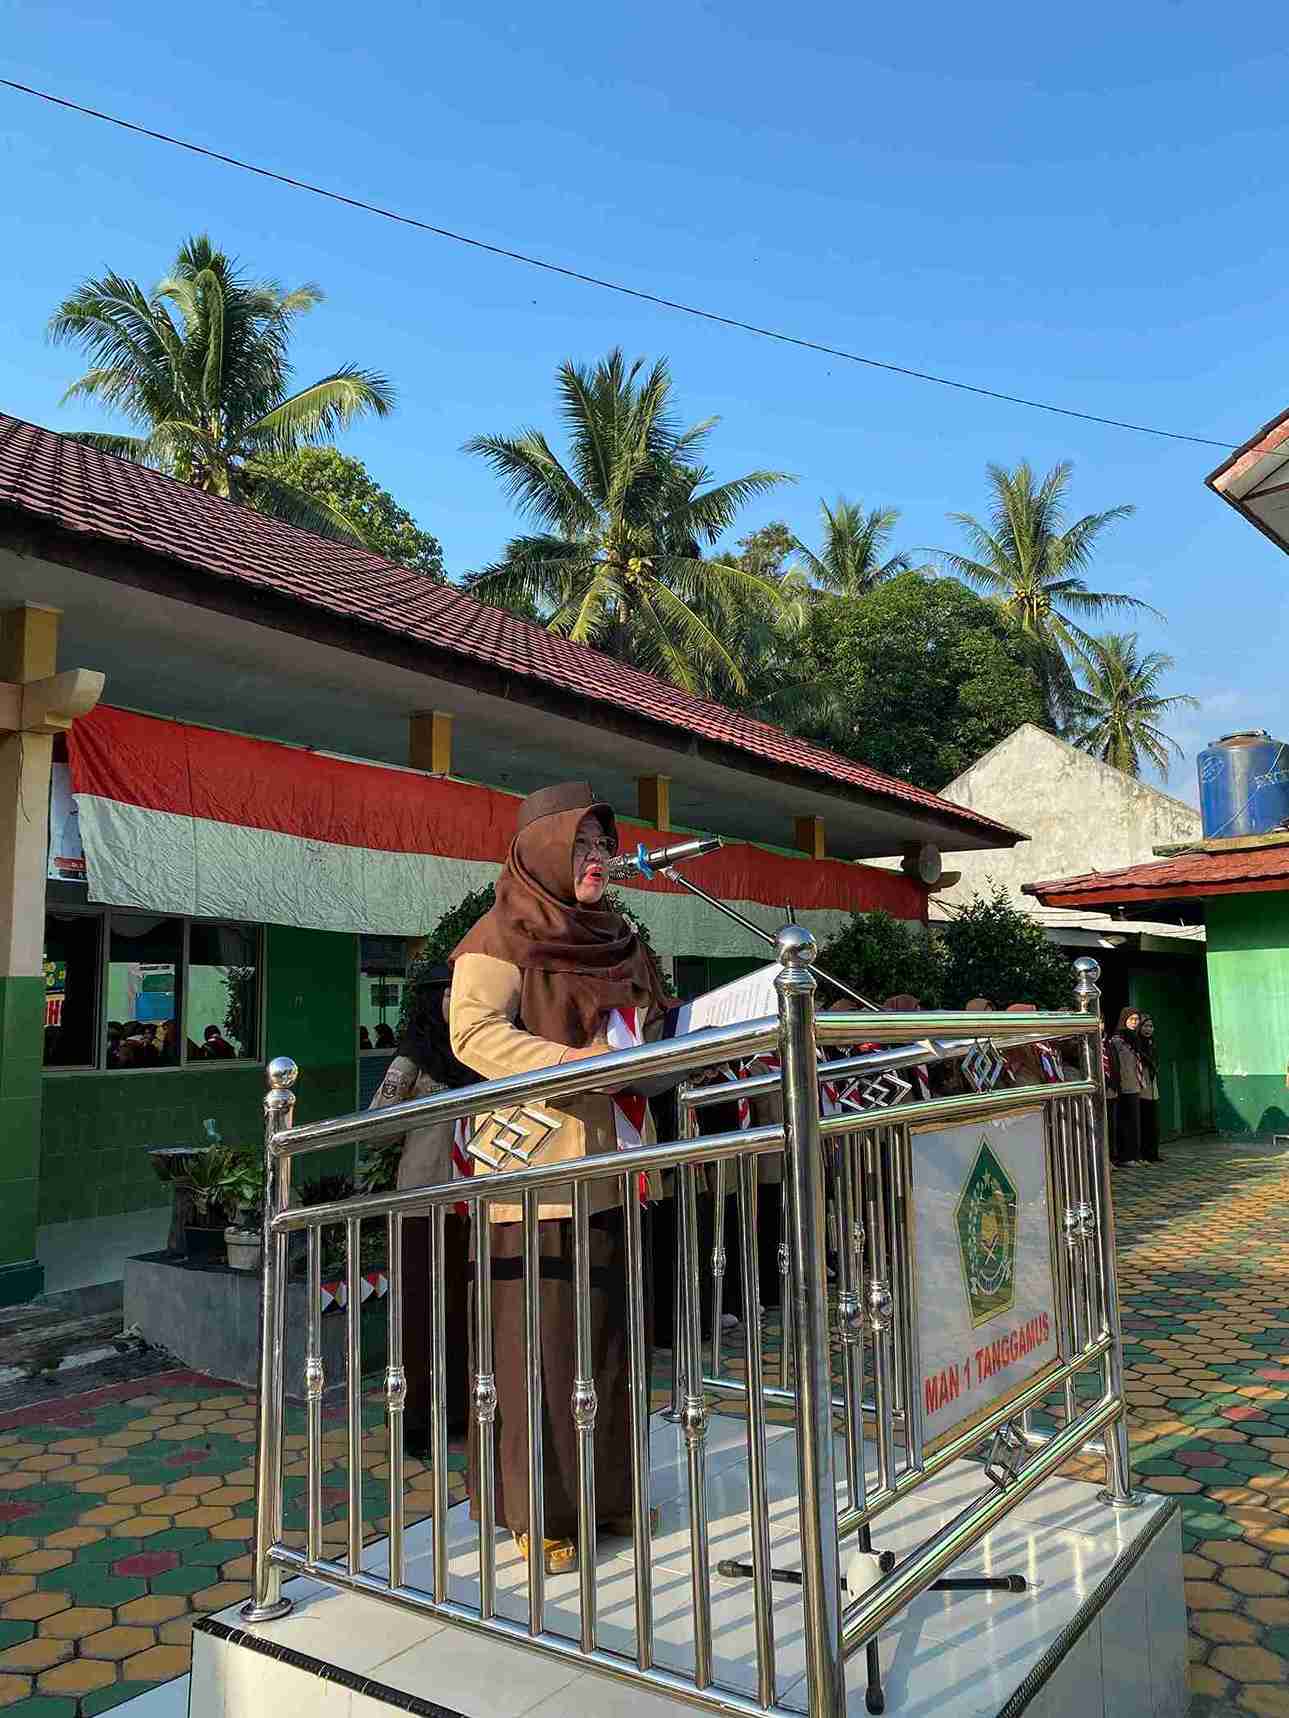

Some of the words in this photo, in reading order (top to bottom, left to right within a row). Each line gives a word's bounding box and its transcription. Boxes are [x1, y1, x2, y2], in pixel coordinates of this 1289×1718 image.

[925, 1363, 960, 1416] MAN
[963, 1356, 970, 1392] 1
[976, 1311, 1049, 1384] TANGGAMUS
